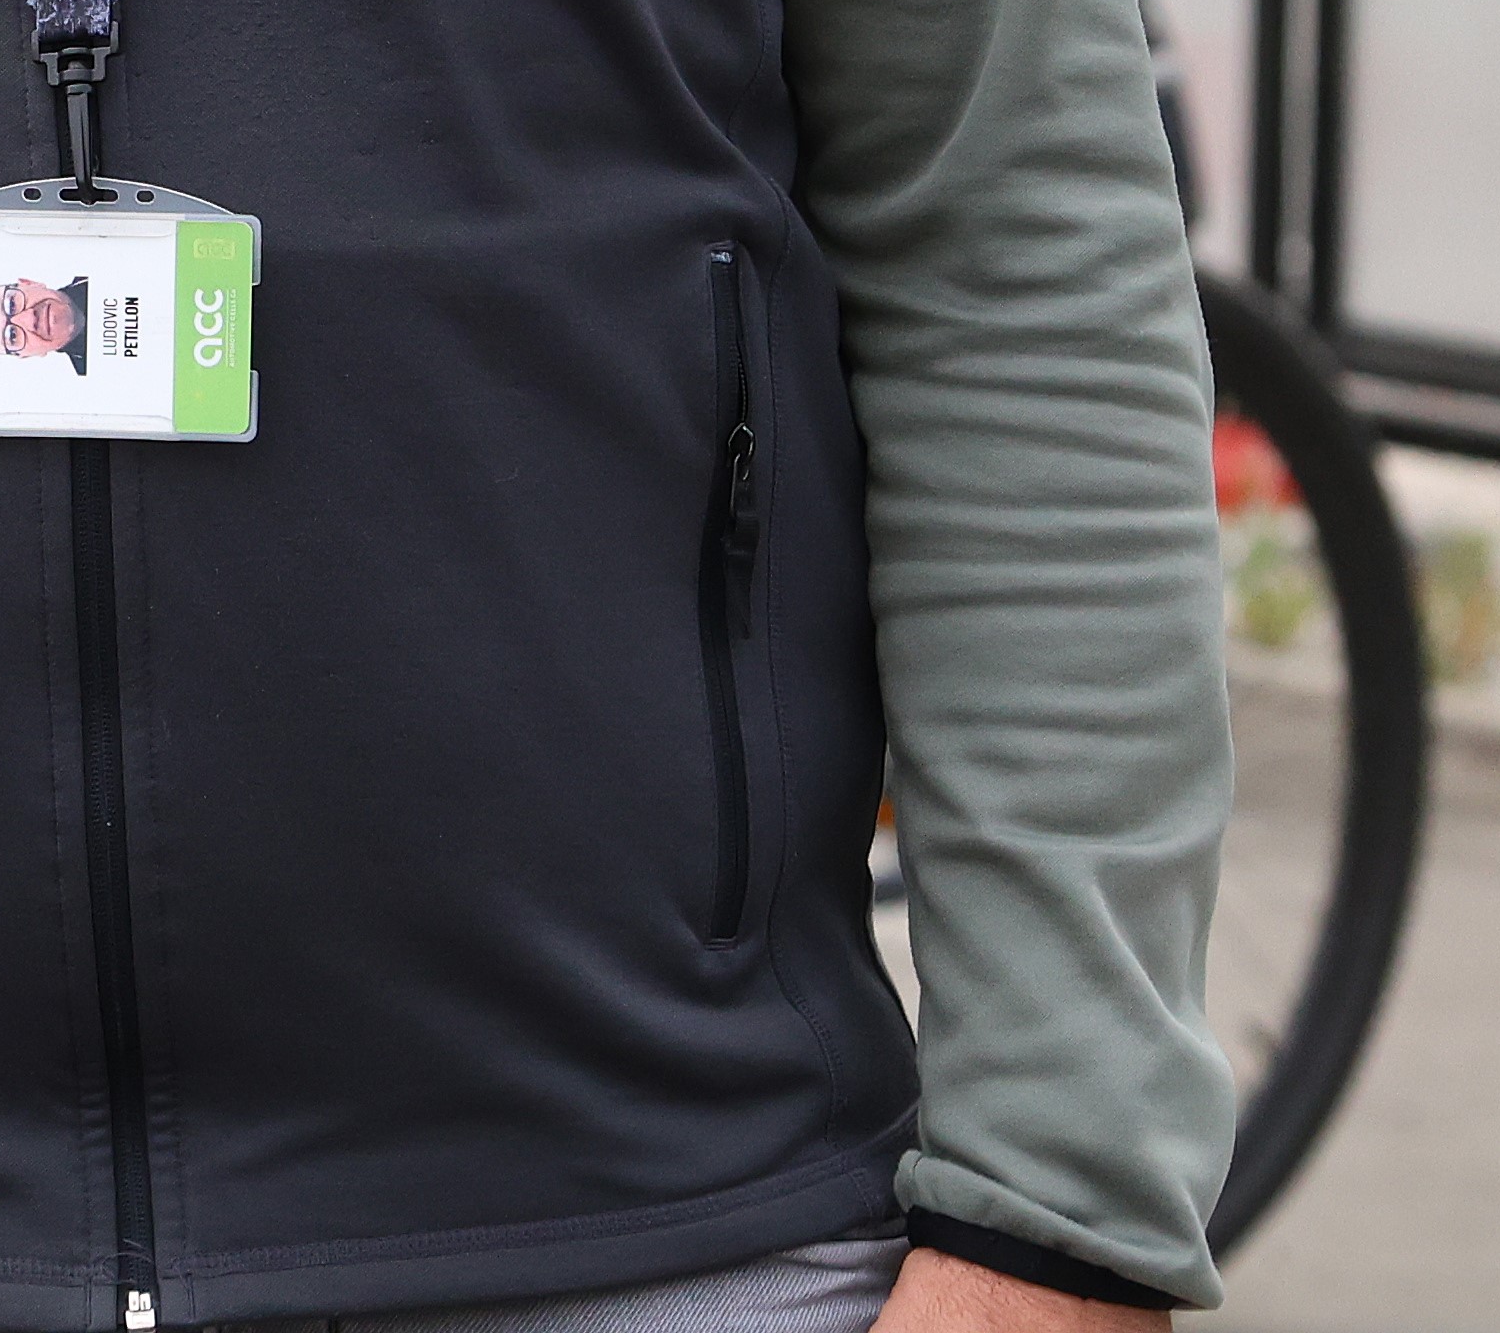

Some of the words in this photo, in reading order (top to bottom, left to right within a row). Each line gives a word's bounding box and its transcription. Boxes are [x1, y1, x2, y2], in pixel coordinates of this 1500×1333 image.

[103, 298, 118, 355] LUDOVIC
[124, 297, 139, 357] PETILLON
[193, 288, 224, 368] acc
